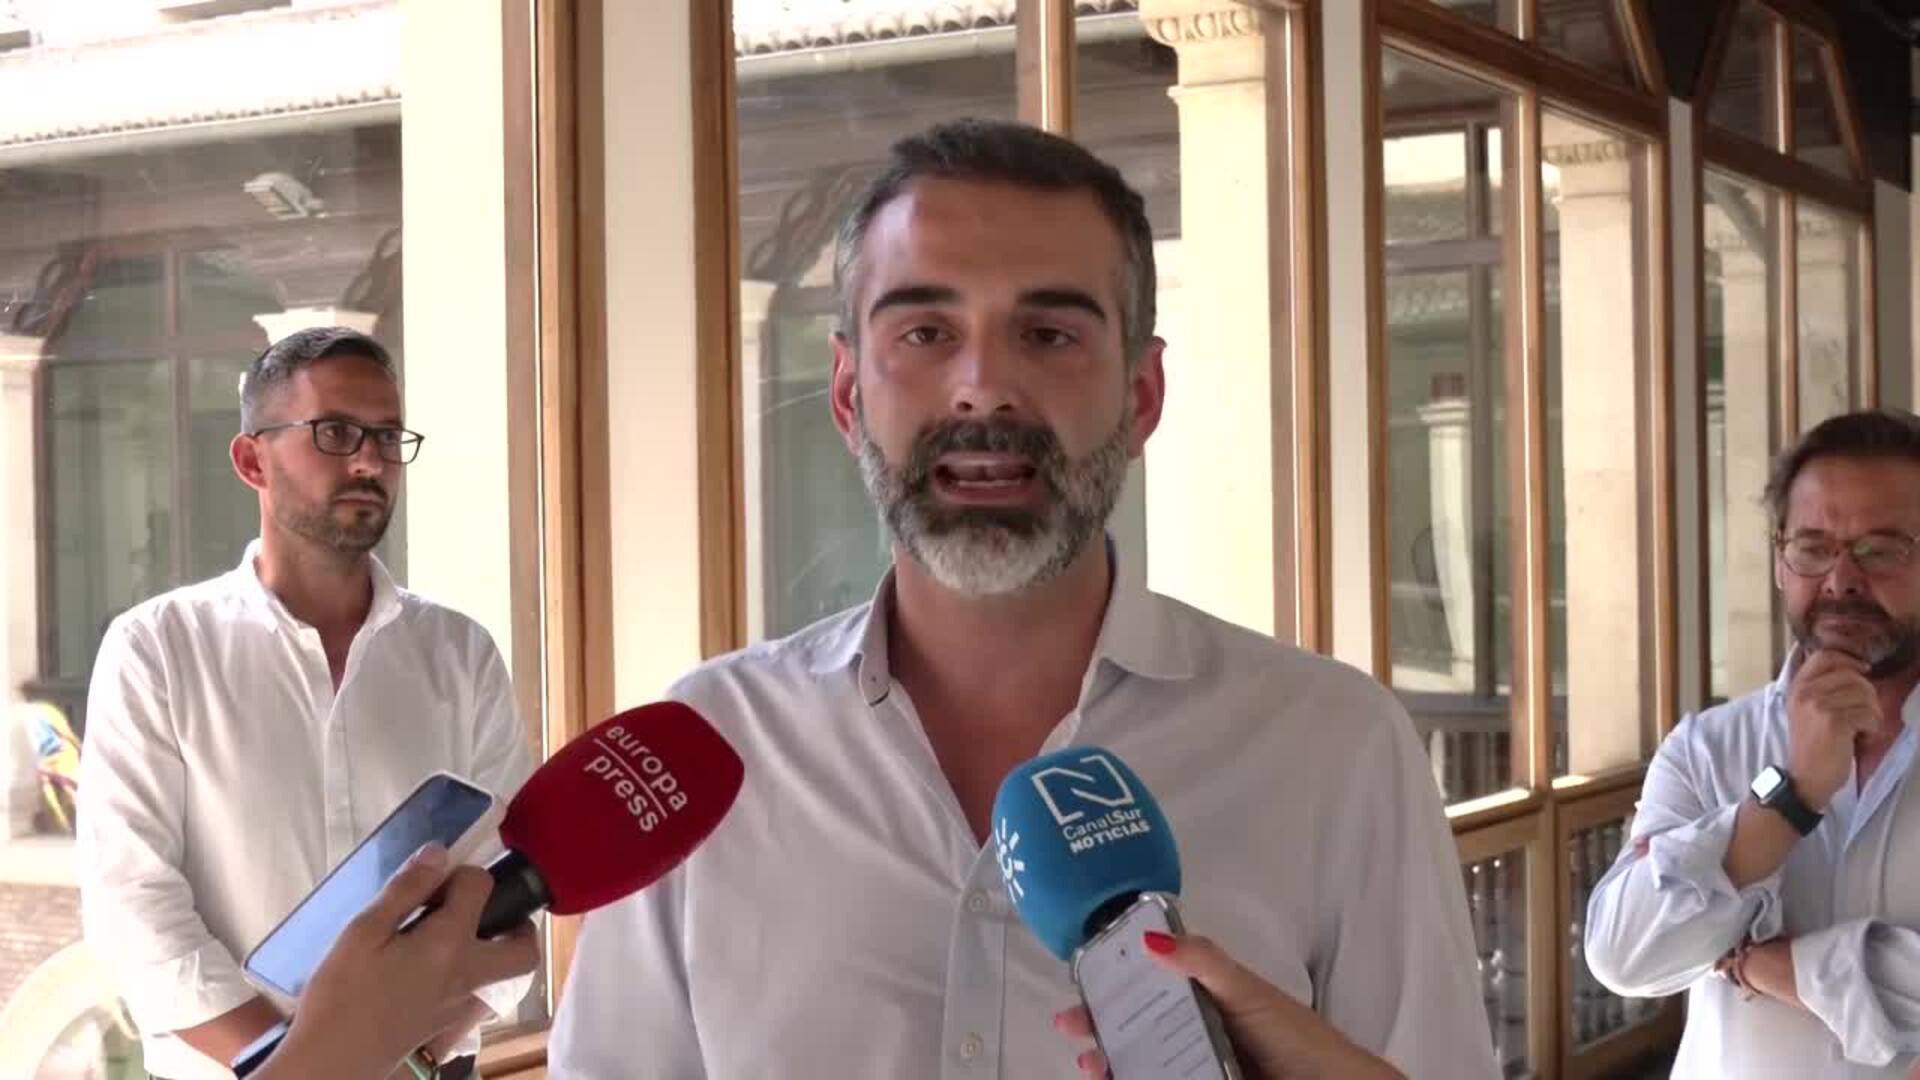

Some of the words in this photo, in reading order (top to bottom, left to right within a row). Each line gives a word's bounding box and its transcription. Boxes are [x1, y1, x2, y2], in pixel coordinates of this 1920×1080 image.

[583, 756, 659, 831] press
[606, 726, 688, 811] europa
[1069, 820, 1150, 853] NOTICIAS
